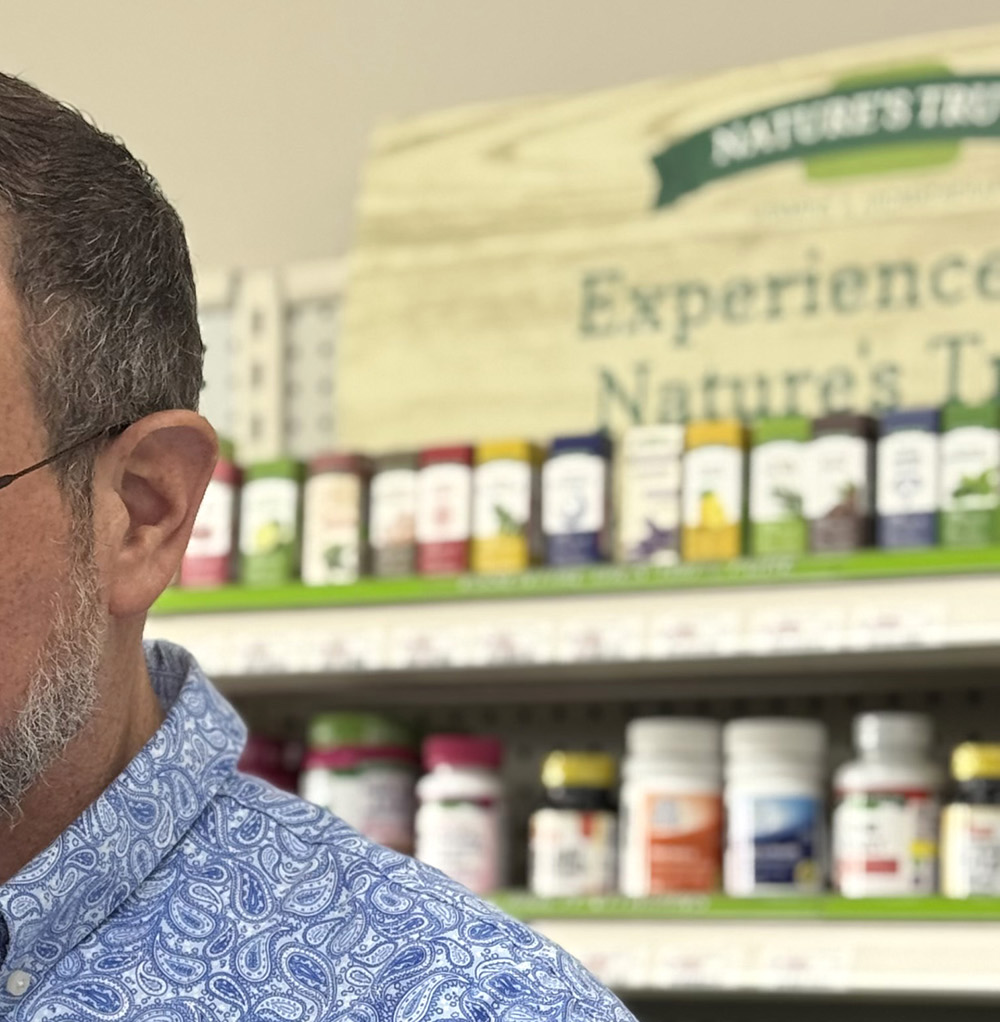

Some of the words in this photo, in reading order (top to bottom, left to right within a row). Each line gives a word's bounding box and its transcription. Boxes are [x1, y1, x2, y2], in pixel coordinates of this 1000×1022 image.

[711, 86, 913, 168] NATURE'S
[578, 246, 1000, 347] Experience
[598, 335, 903, 427] Nature's
